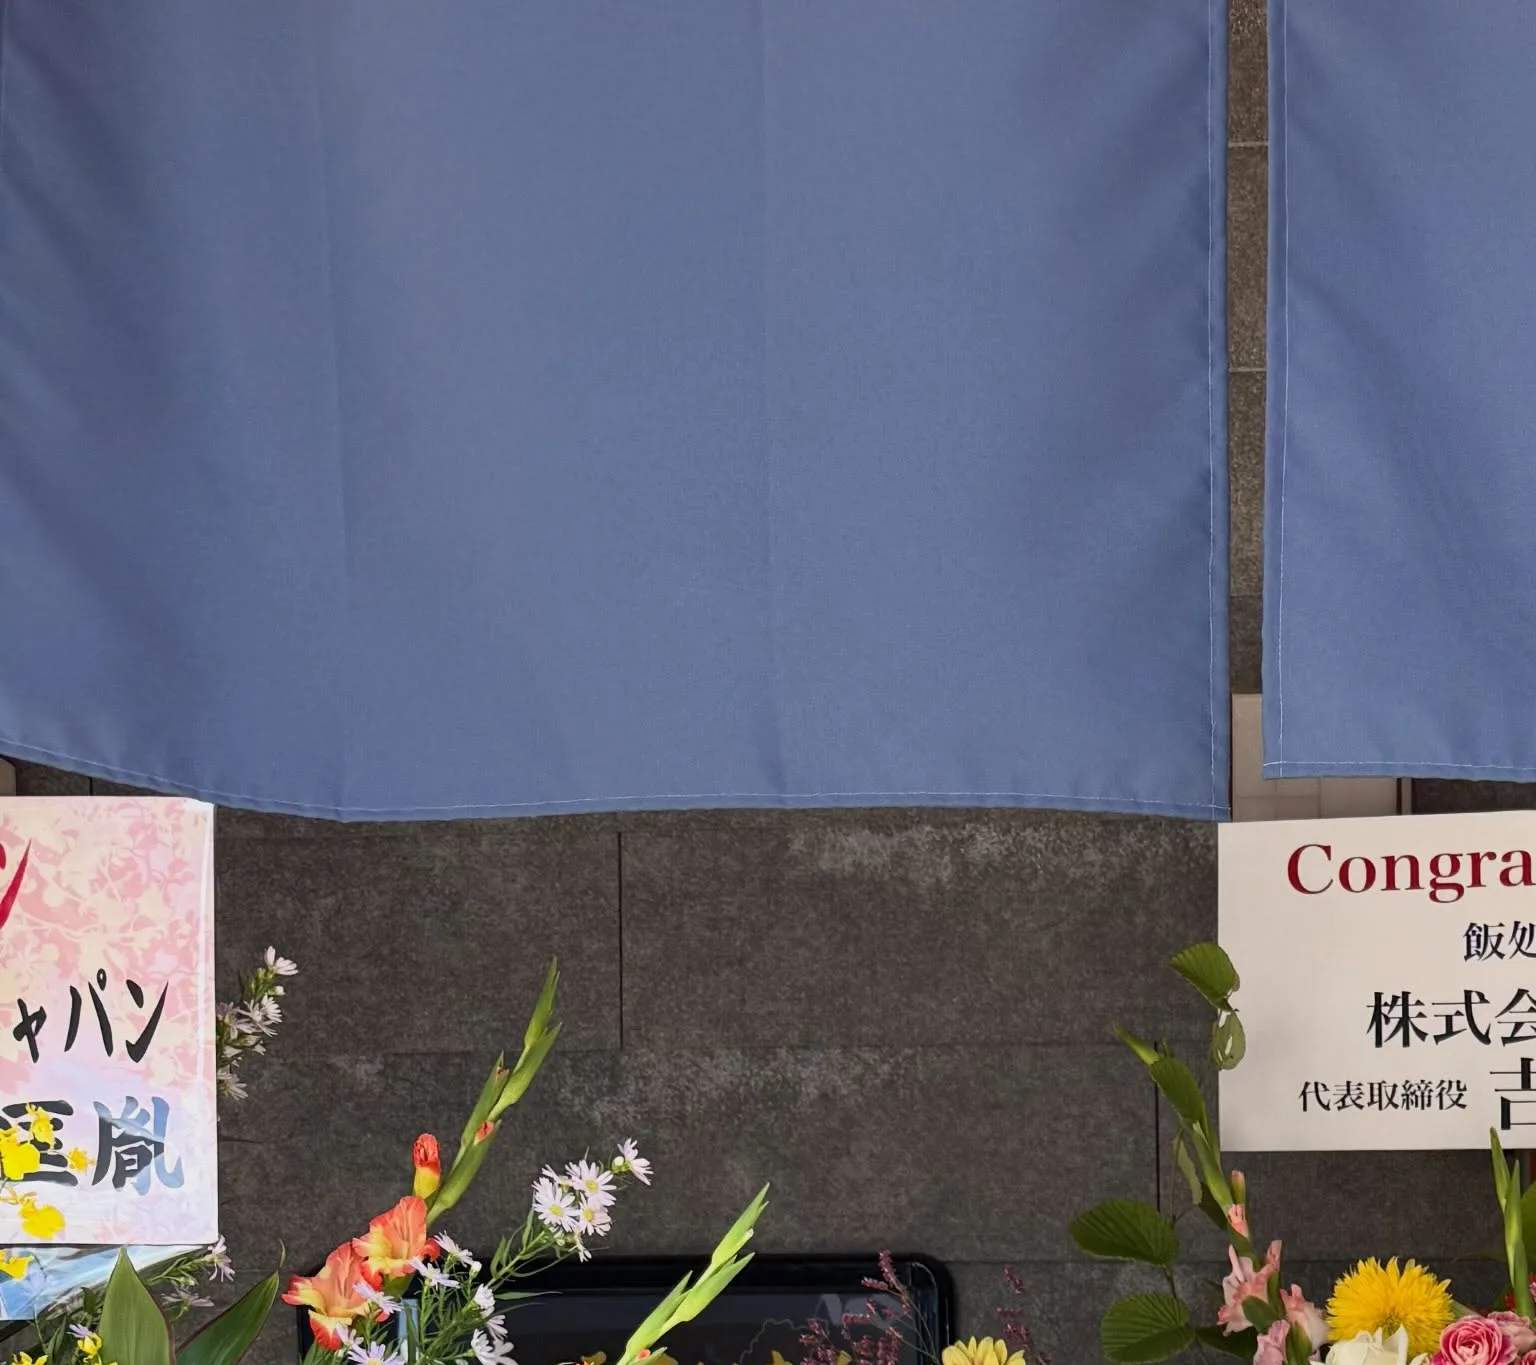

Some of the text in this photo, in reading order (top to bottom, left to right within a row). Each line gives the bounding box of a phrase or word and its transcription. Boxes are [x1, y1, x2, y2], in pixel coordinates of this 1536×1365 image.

[1298, 1079, 1468, 1113] 代表取締役
